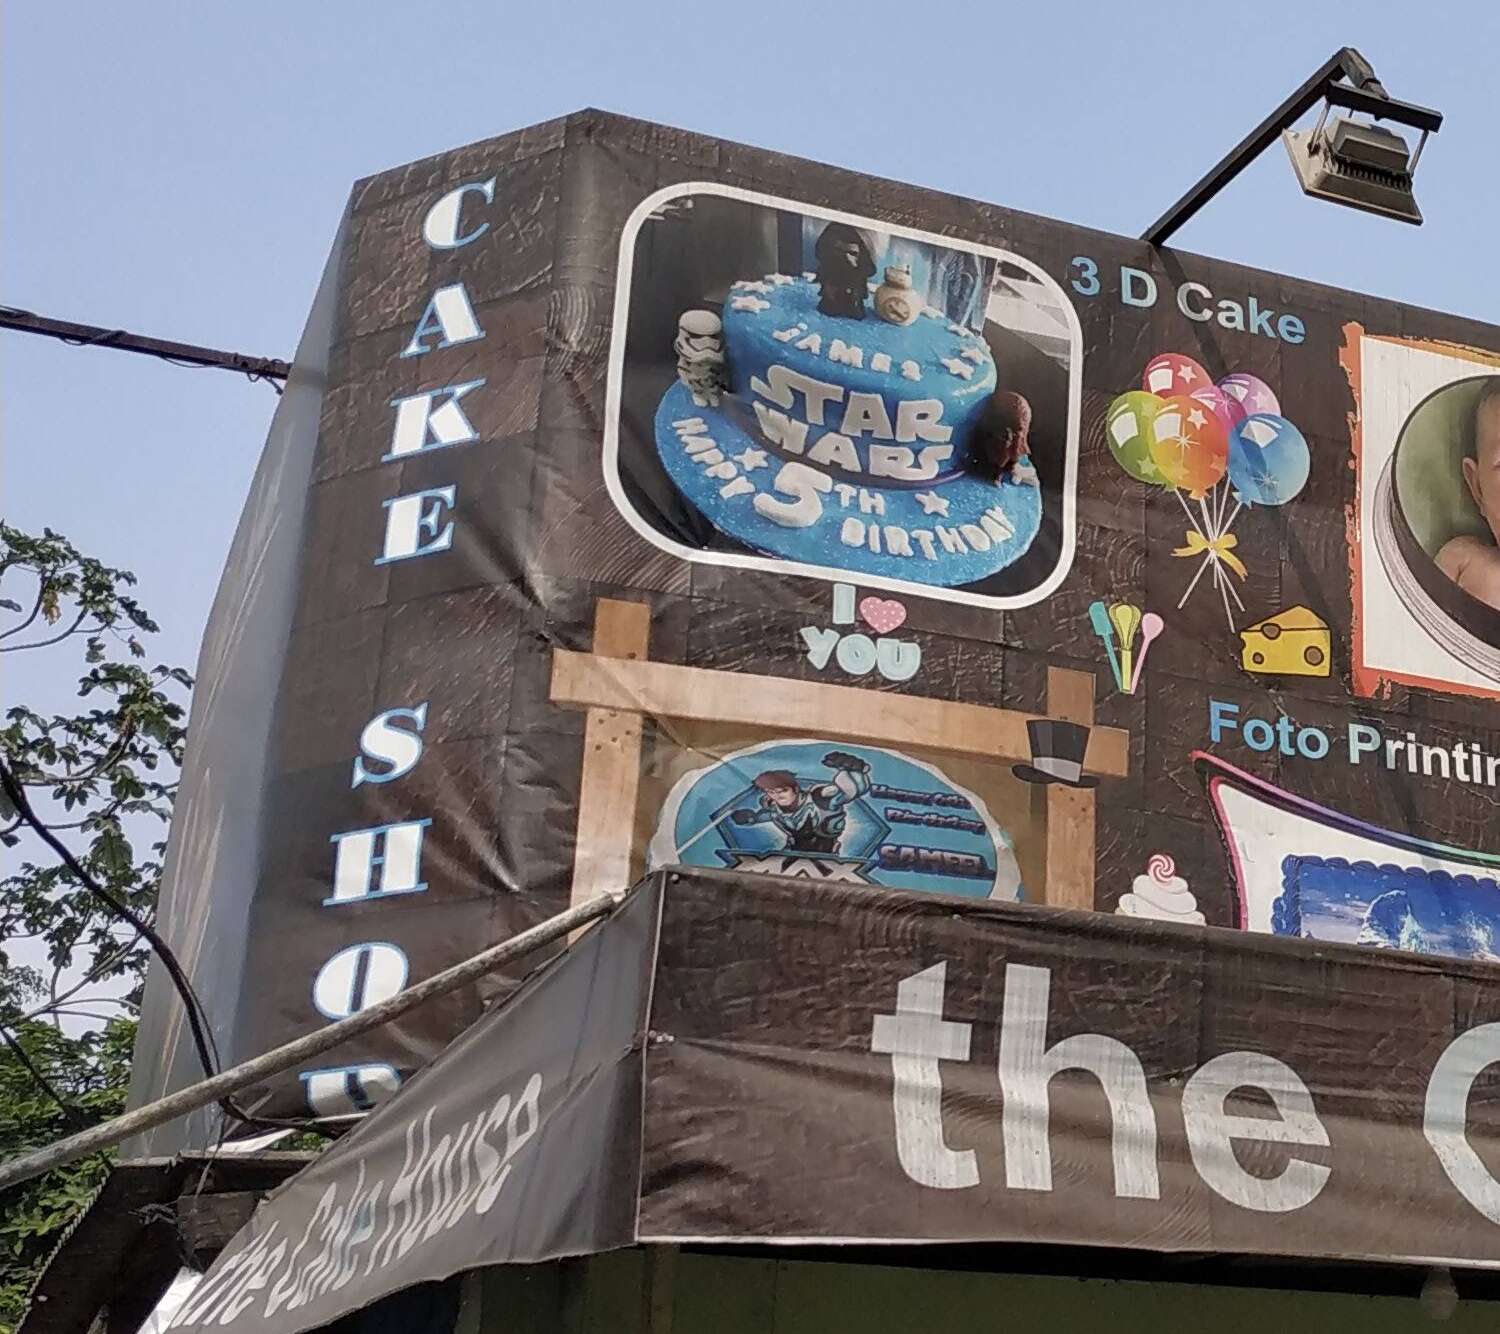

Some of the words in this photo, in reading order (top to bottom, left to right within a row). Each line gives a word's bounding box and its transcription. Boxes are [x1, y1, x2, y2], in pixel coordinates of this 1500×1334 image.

[1072, 257, 1101, 295] 3
[1121, 266, 1158, 308] D
[1178, 282, 1307, 345] Cake
[372, 177, 497, 567] CAKE
[750, 363, 954, 443] STAR
[750, 399, 956, 483] WARS
[671, 417, 758, 501] HAPPY
[840, 506, 1016, 561] BIRTHDAY
[832, 582, 857, 626] I
[800, 624, 922, 682] YOU
[1209, 700, 1330, 762] Foto
[870, 964, 1332, 1212] the
